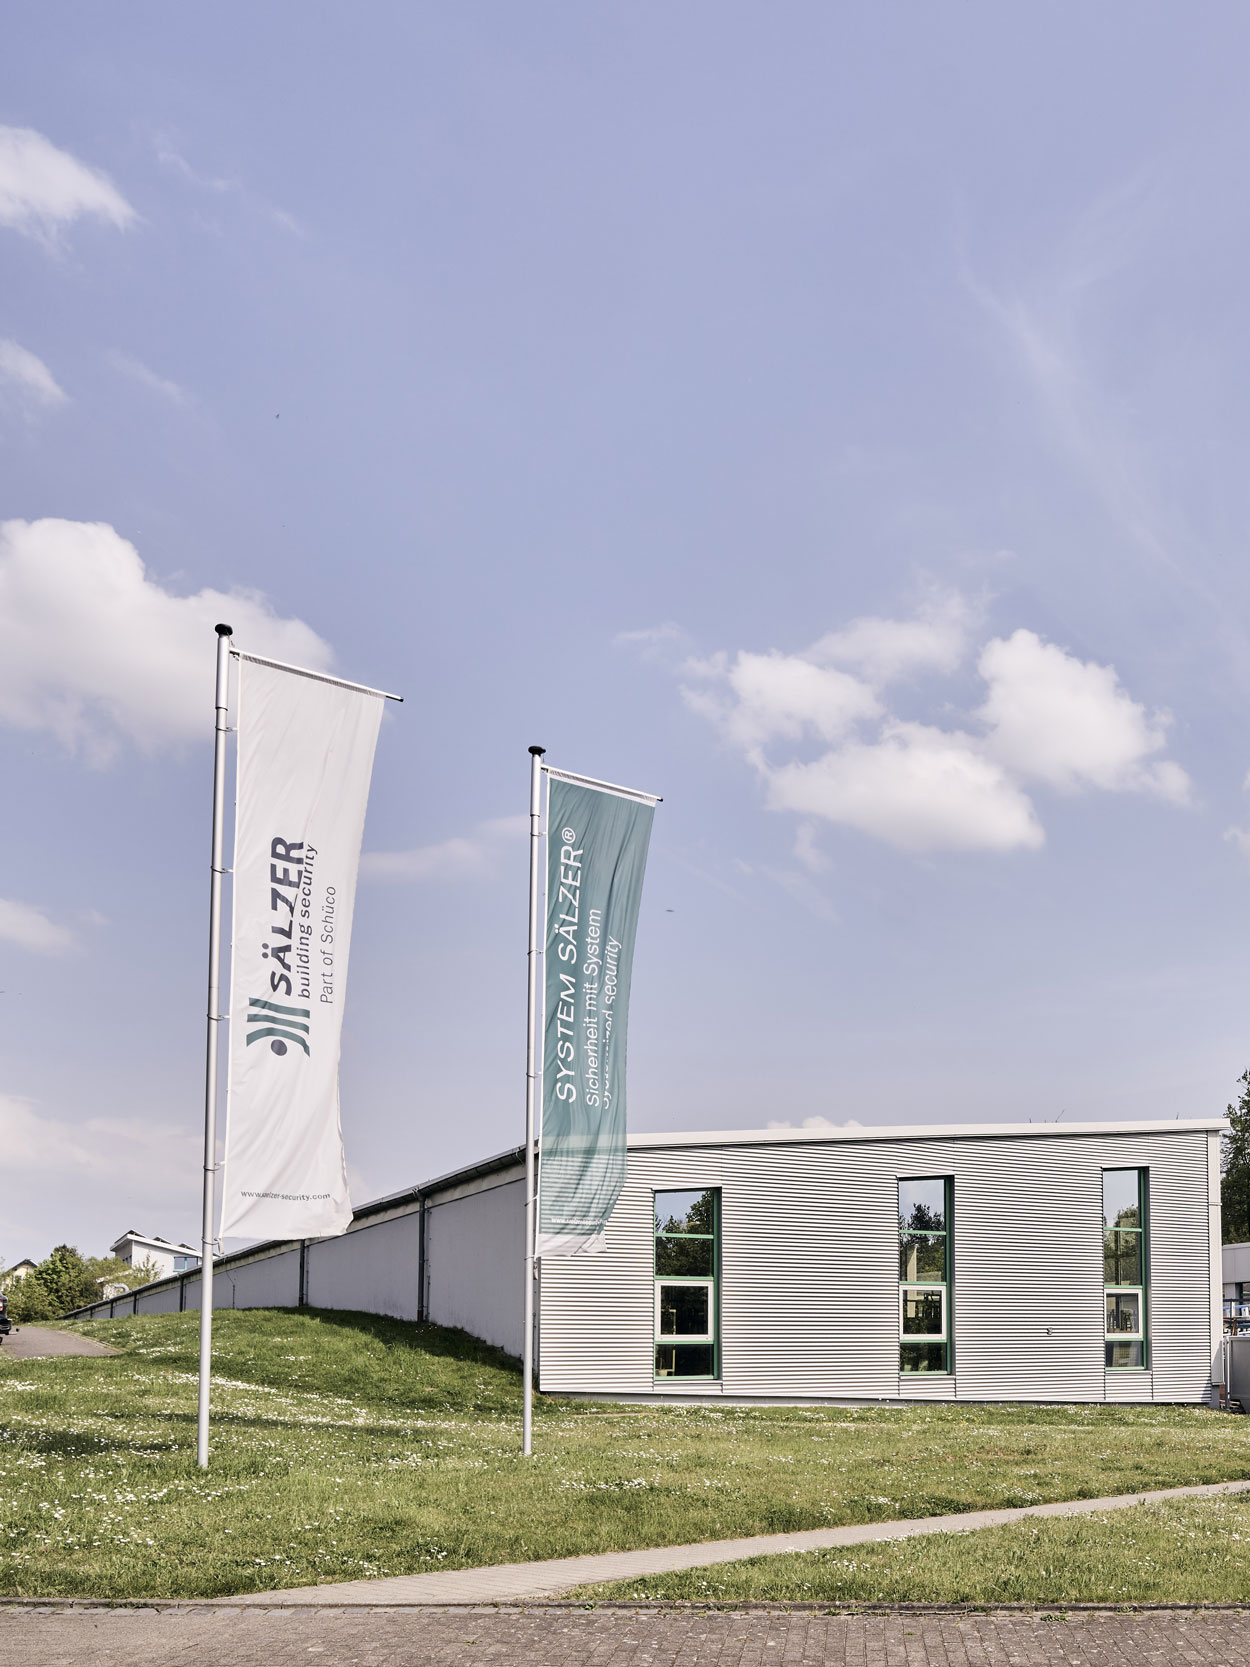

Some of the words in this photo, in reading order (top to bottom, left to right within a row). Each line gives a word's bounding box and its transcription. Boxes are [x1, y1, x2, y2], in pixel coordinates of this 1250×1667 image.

[261, 836, 304, 997] SÄLZER
[300, 844, 318, 919] security
[320, 886, 336, 944] Schüco
[296, 924, 313, 999] building
[321, 950, 334, 966] of
[583, 909, 602, 977] System
[604, 935, 622, 1005] security
[320, 972, 334, 1004] Part
[583, 982, 598, 1011] mit
[556, 973, 577, 1103] SYSTEM
[583, 1016, 599, 1107] Sicherheit
